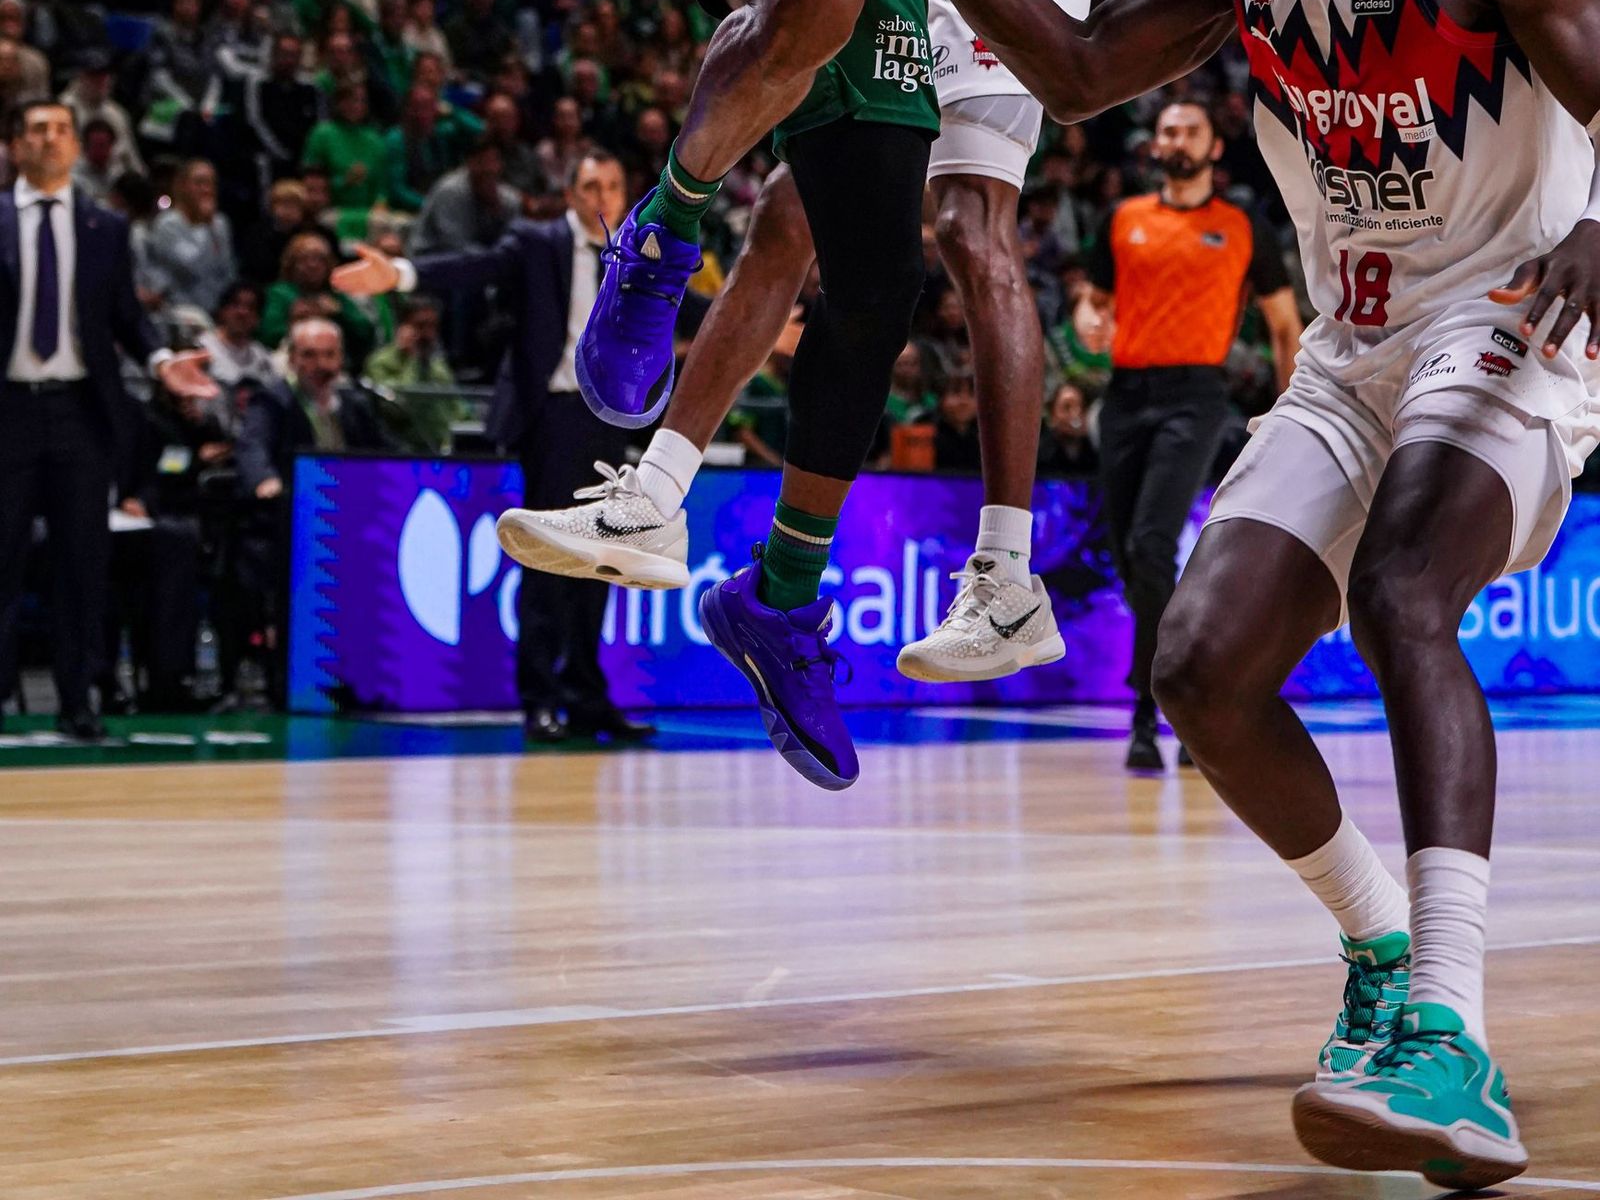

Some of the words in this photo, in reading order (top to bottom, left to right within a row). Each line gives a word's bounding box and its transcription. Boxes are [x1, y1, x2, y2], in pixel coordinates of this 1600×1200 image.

[1354, 0, 1391, 10] endesa
[878, 14, 917, 32] sabor
[872, 48, 934, 93] laga
[1271, 64, 1434, 139] ingroyal
[1384, 214, 1444, 231] eficiente
[1334, 249, 1393, 328] 18
